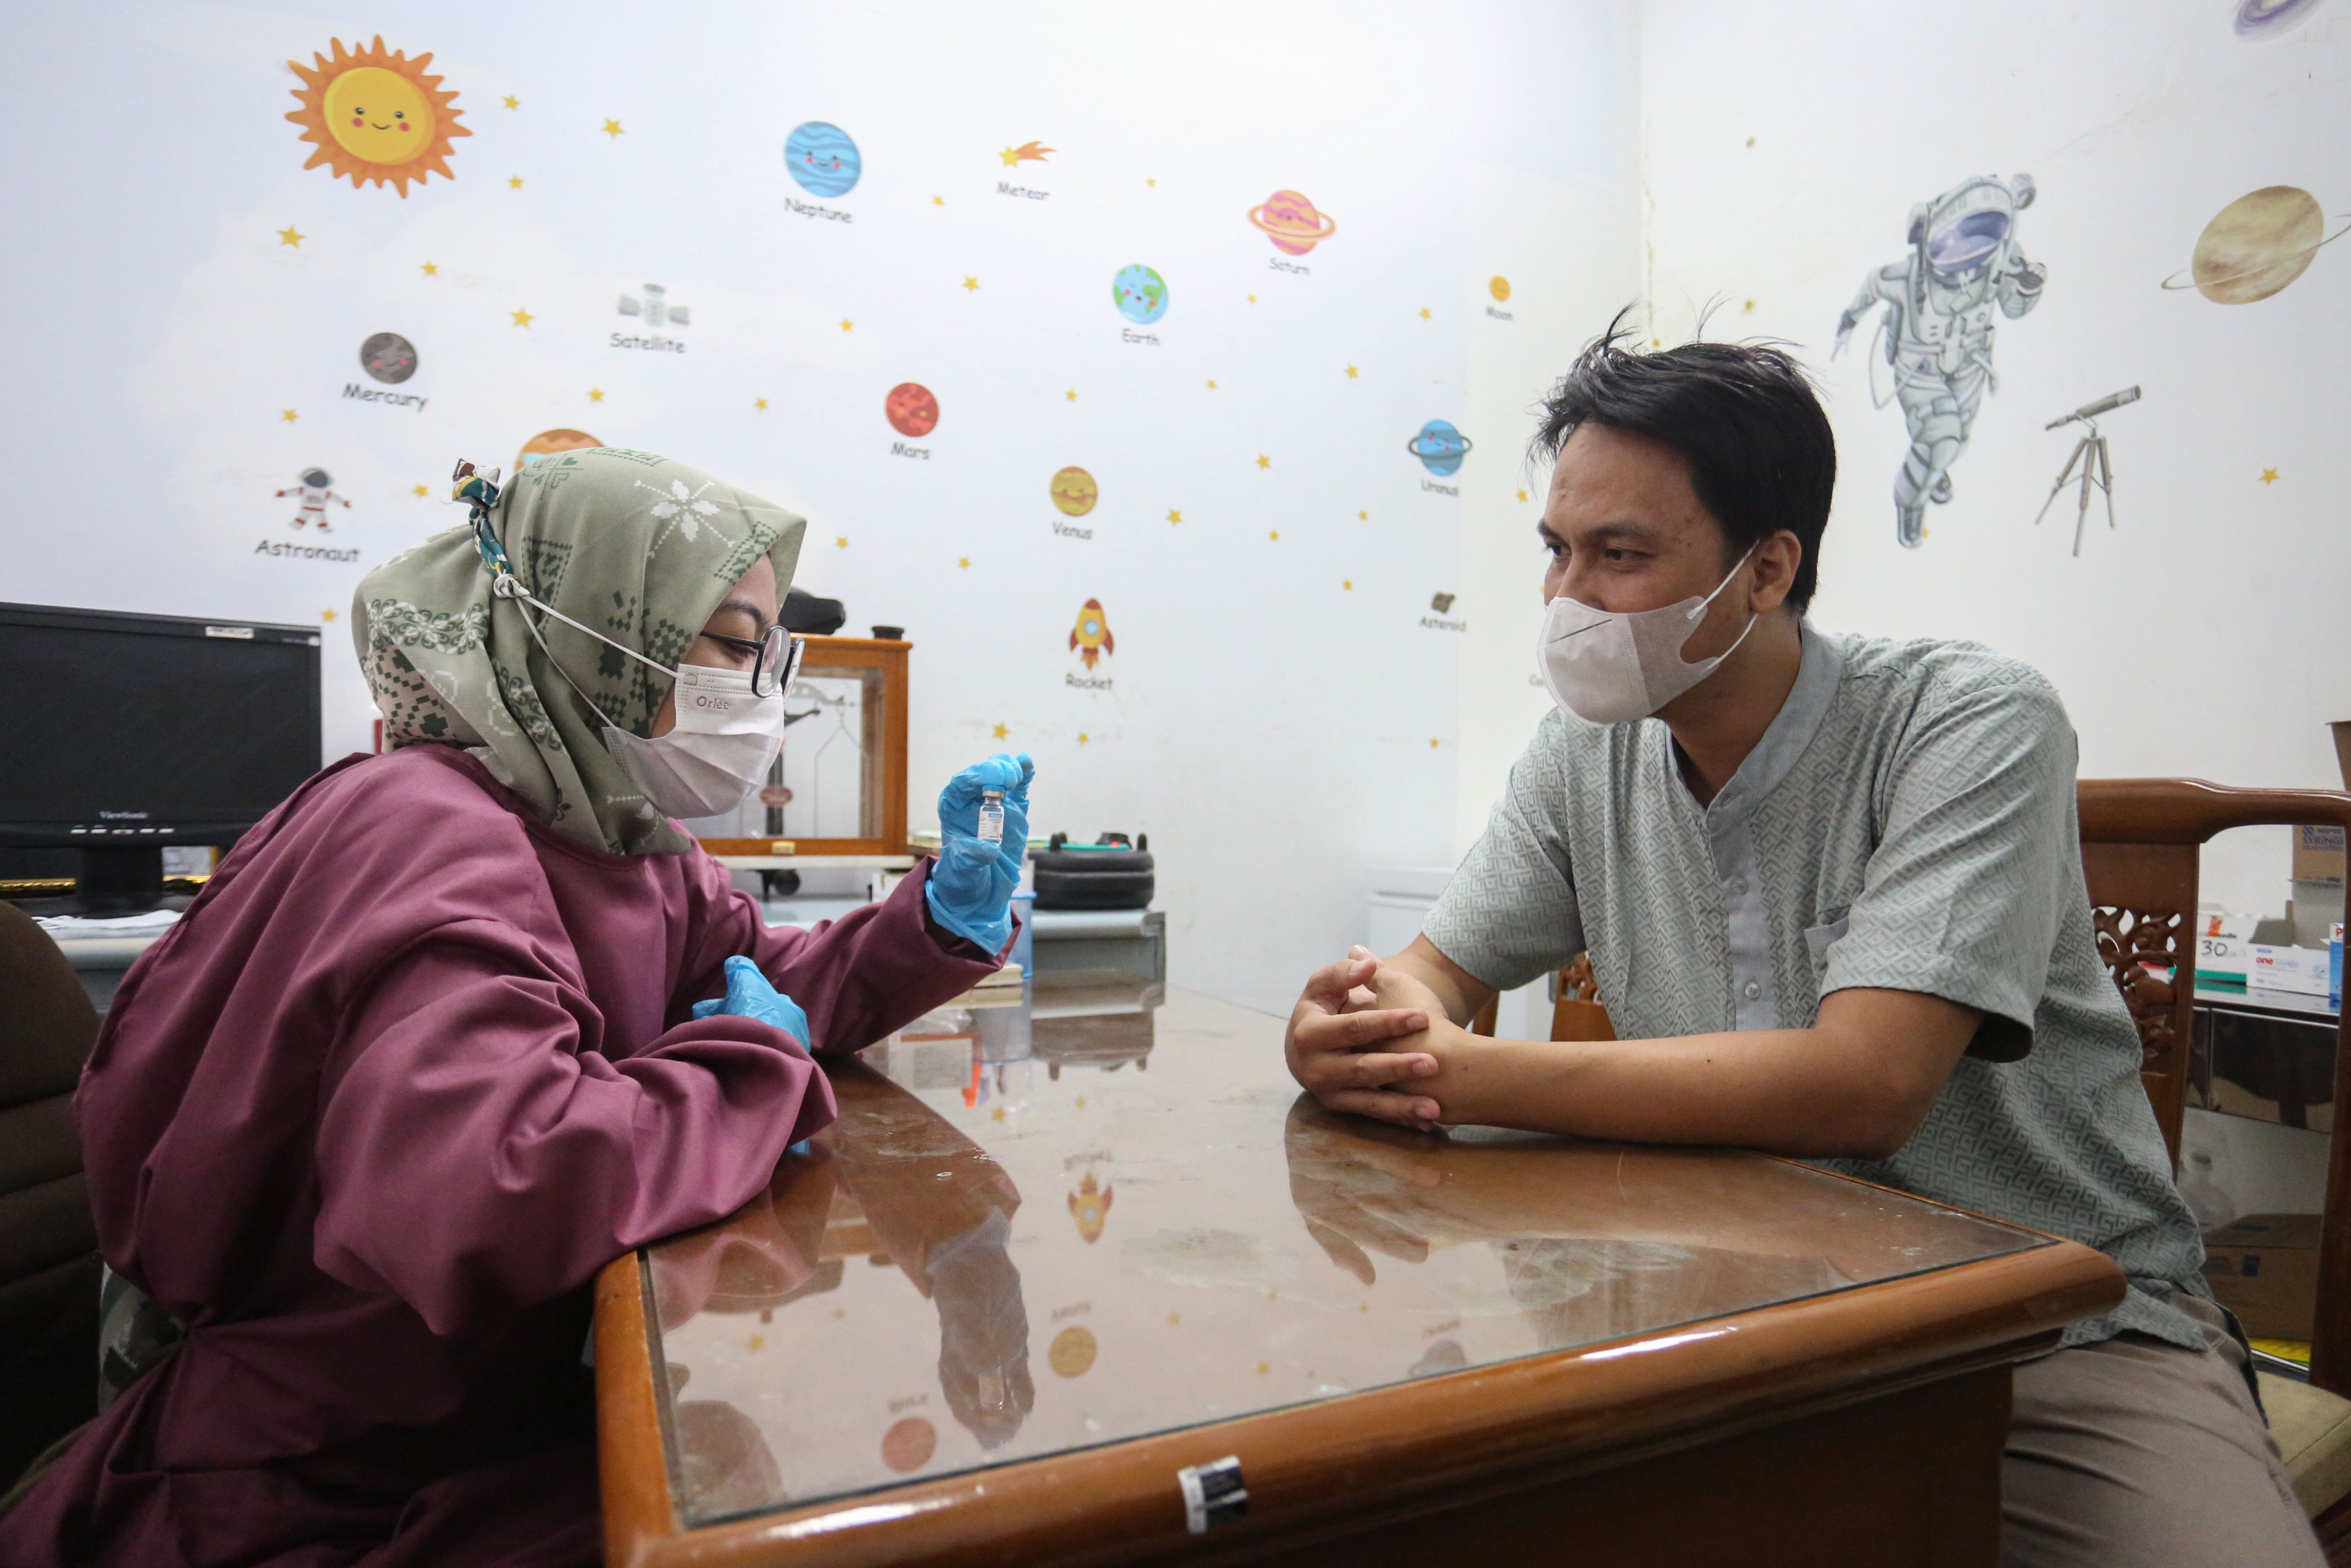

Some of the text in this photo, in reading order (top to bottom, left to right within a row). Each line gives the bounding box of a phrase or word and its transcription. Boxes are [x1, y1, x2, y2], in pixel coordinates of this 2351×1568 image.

[998, 181, 1050, 200] Meteor
[784, 197, 853, 223] Neptune
[1269, 257, 1311, 275] Saturn
[609, 332, 686, 354] Satellite
[1122, 328, 1161, 347] Earth
[342, 382, 429, 412] Mercury
[891, 441, 931, 460] Mars
[1421, 479, 1459, 496] Uranus
[1052, 521, 1093, 539] Venus
[254, 539, 360, 563] Astronaut
[1419, 617, 1467, 632] Asteroid
[1065, 673, 1113, 690] Rocket
[696, 696, 729, 710] Orlee
[2201, 940, 2227, 957] 30
